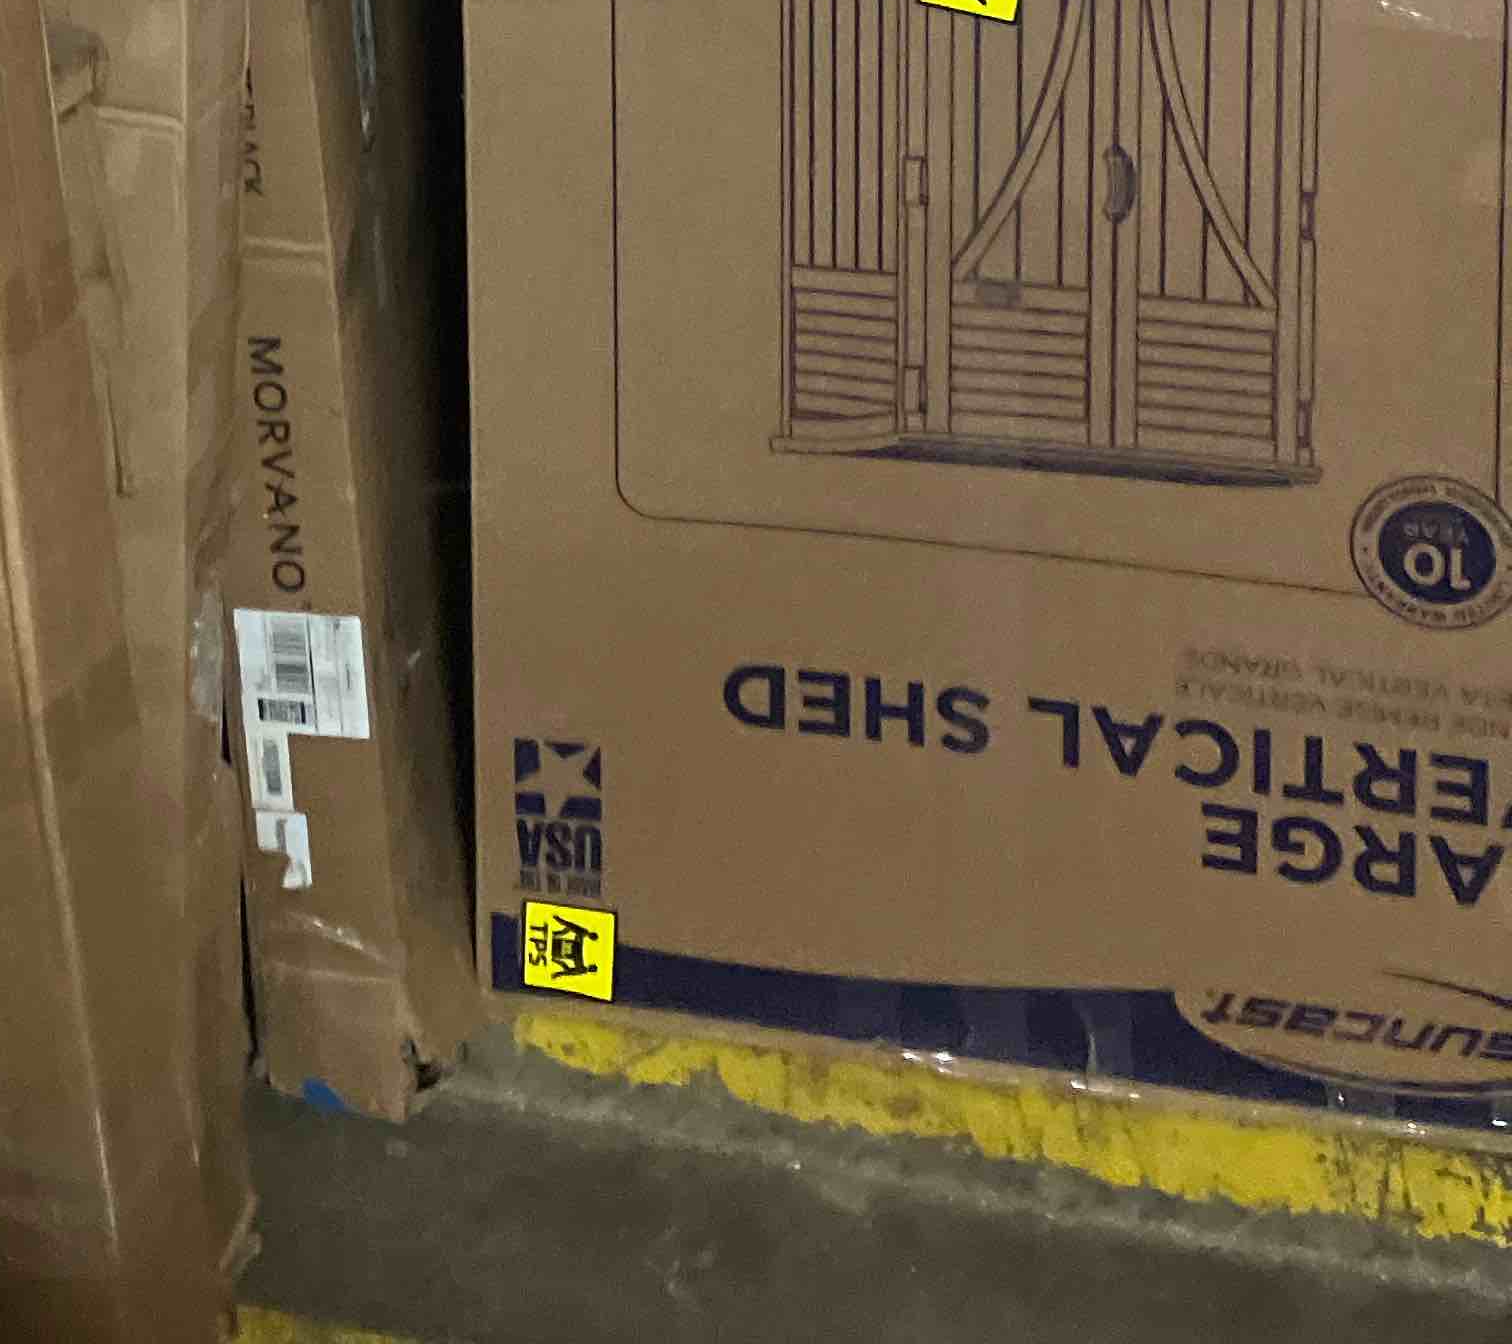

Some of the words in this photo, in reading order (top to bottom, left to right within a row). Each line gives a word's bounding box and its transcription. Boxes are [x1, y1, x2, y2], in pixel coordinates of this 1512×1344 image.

[248, 336, 305, 592] MORVANO
[1403, 543, 1472, 592] 10
[722, 664, 990, 756] SHED
[1028, 697, 1512, 831] ERTICAL
[516, 820, 601, 872] USA
[1201, 802, 1505, 909] ARGE
[529, 921, 549, 968] TPS
